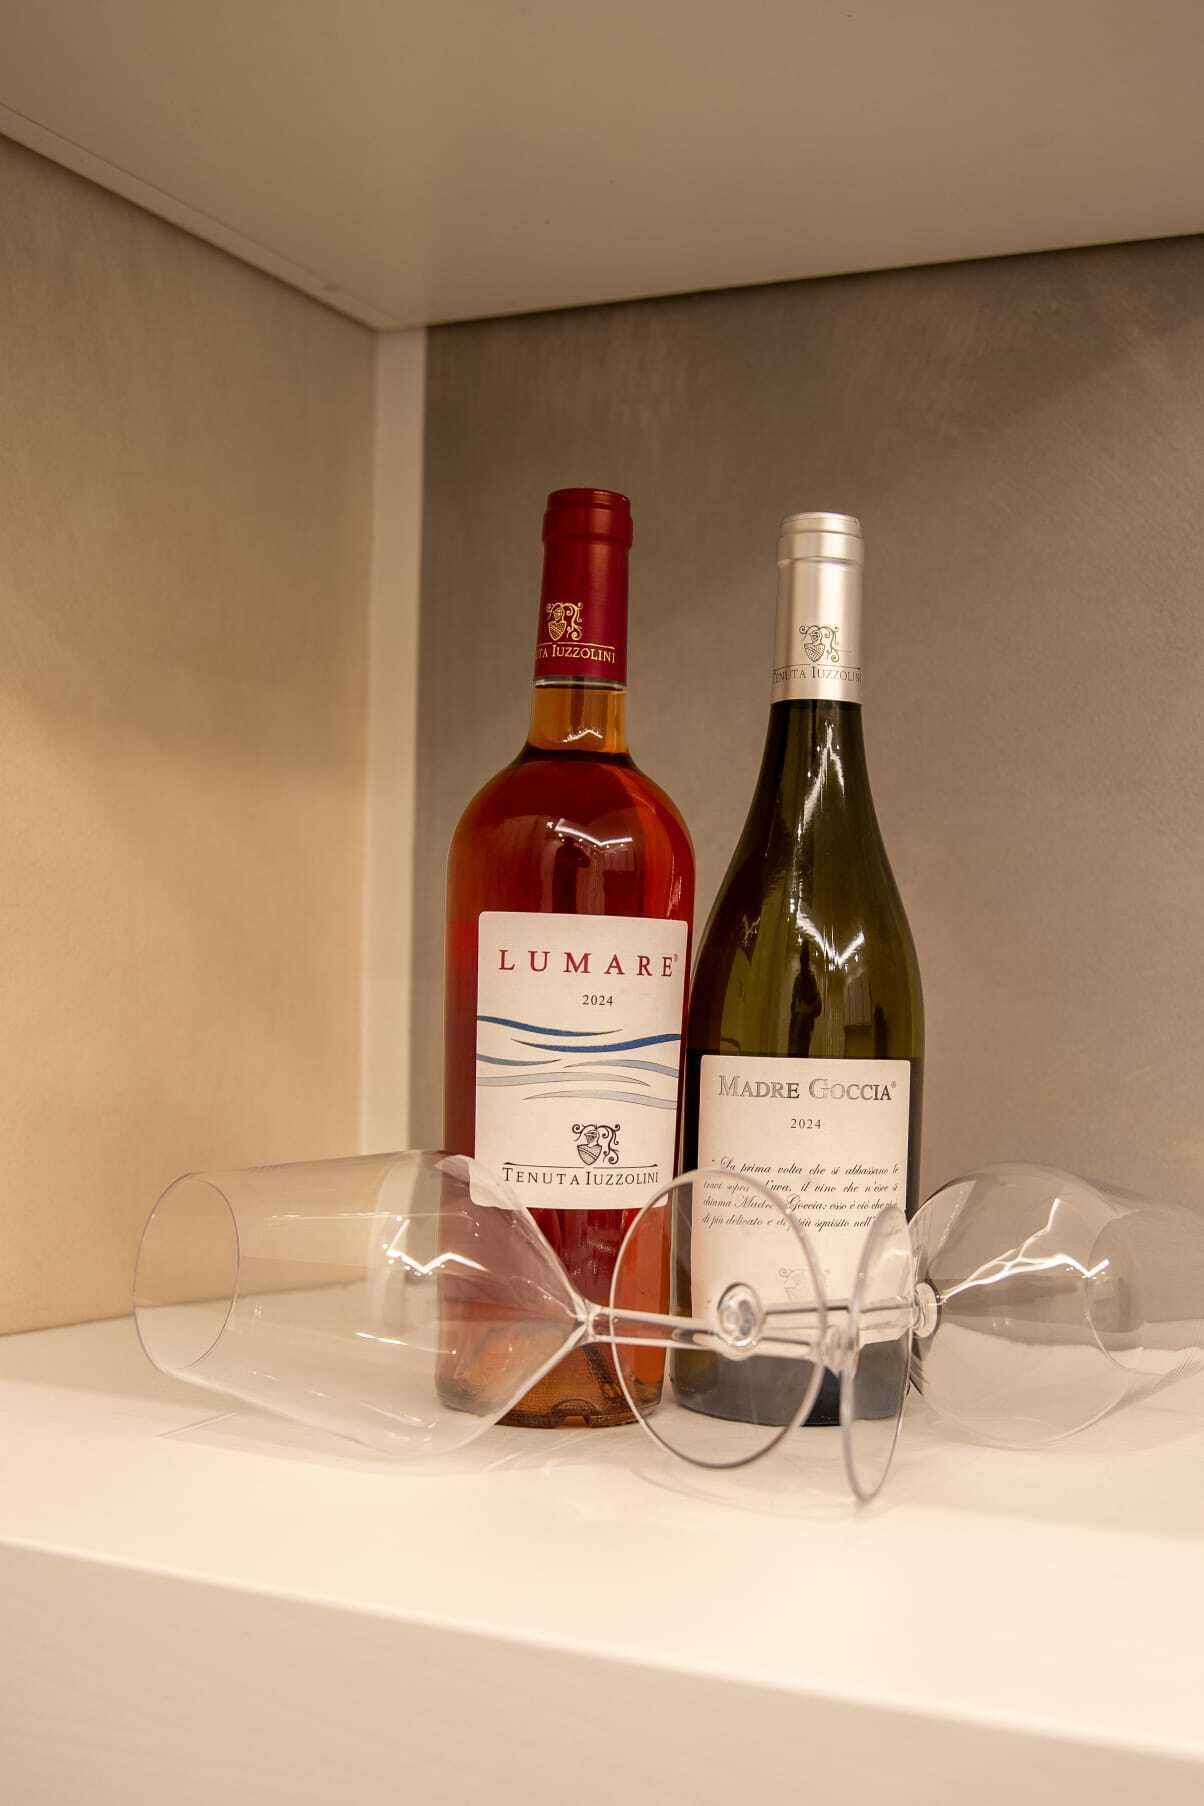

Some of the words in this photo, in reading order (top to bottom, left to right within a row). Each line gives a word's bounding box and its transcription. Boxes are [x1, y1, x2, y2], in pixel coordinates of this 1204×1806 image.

[552, 644, 616, 664] IUZZOLINI
[582, 994, 613, 1006] 2024
[718, 1075, 800, 1099] MADRE
[790, 1118, 822, 1130] 2024
[740, 1163, 771, 1174] prima
[777, 1163, 802, 1174] volta
[808, 1163, 825, 1175] che
[502, 1167, 580, 1185] TENUTA
[586, 1171, 659, 1186] IUZZOLINI
[814, 1184, 836, 1193] vino
[843, 1181, 858, 1192] che
